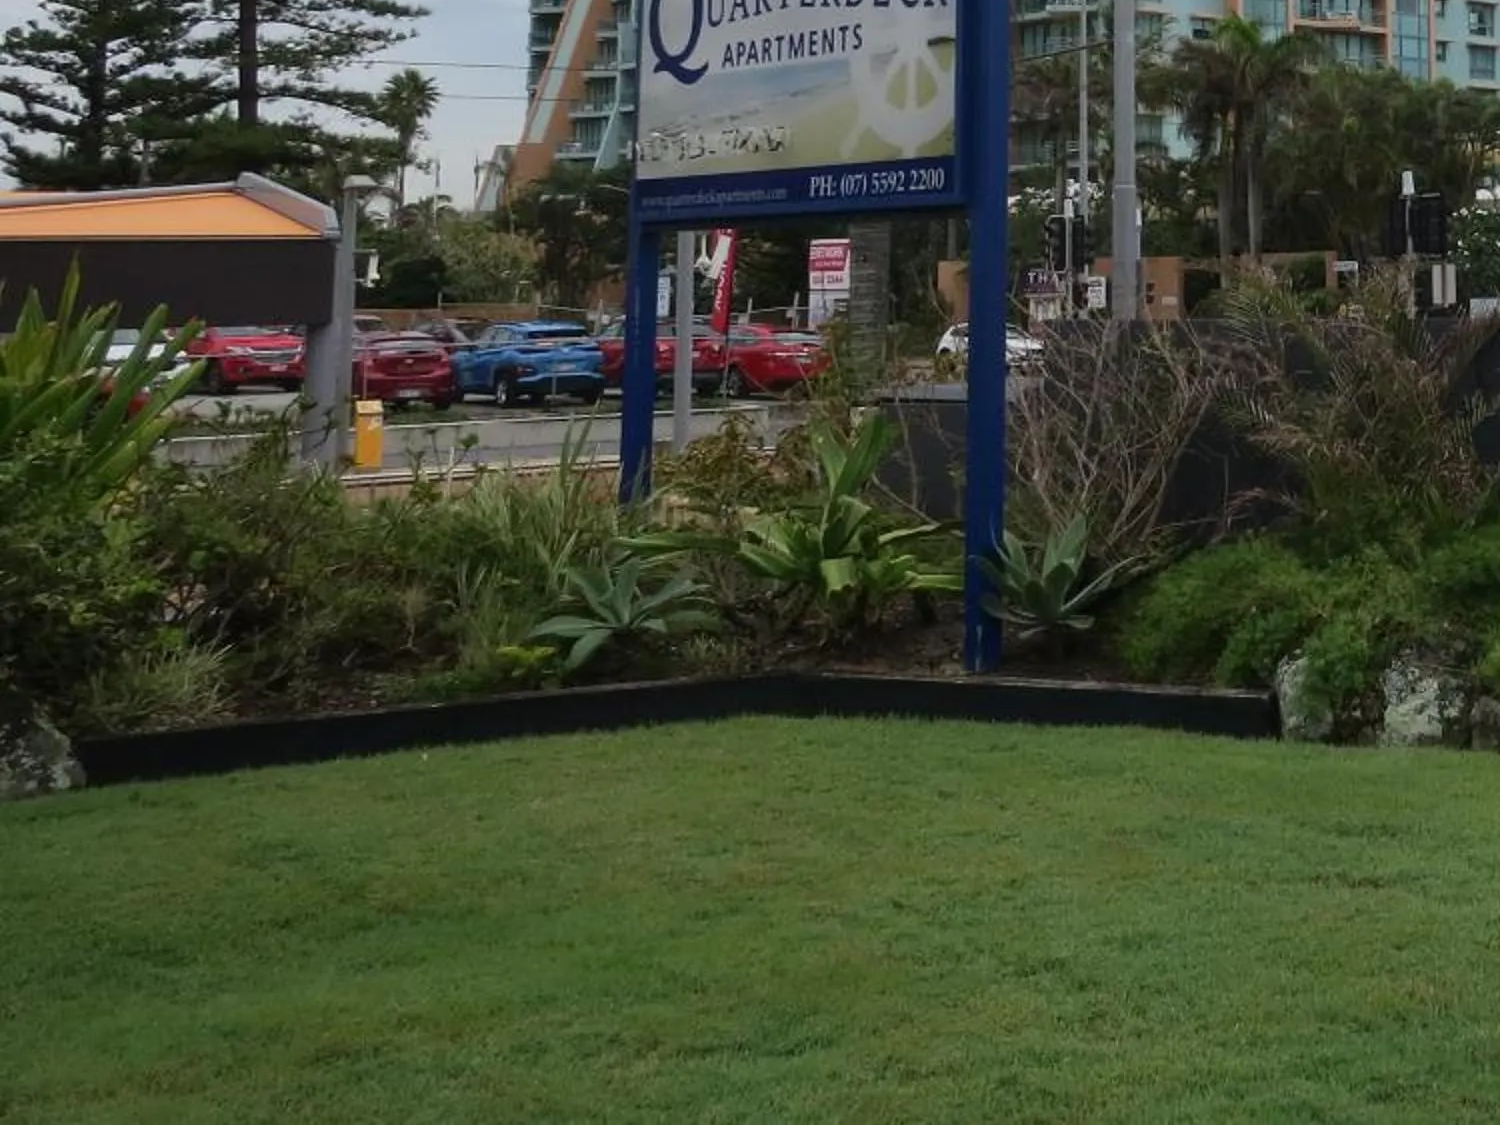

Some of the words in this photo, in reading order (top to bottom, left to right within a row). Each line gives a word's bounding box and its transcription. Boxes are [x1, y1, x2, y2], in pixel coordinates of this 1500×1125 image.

[721, 24, 863, 68] APARTMENTS
[809, 176, 837, 198] PH:
[840, 174, 867, 196] (07)
[871, 171, 905, 194] 5592
[909, 168, 945, 191] 2200
